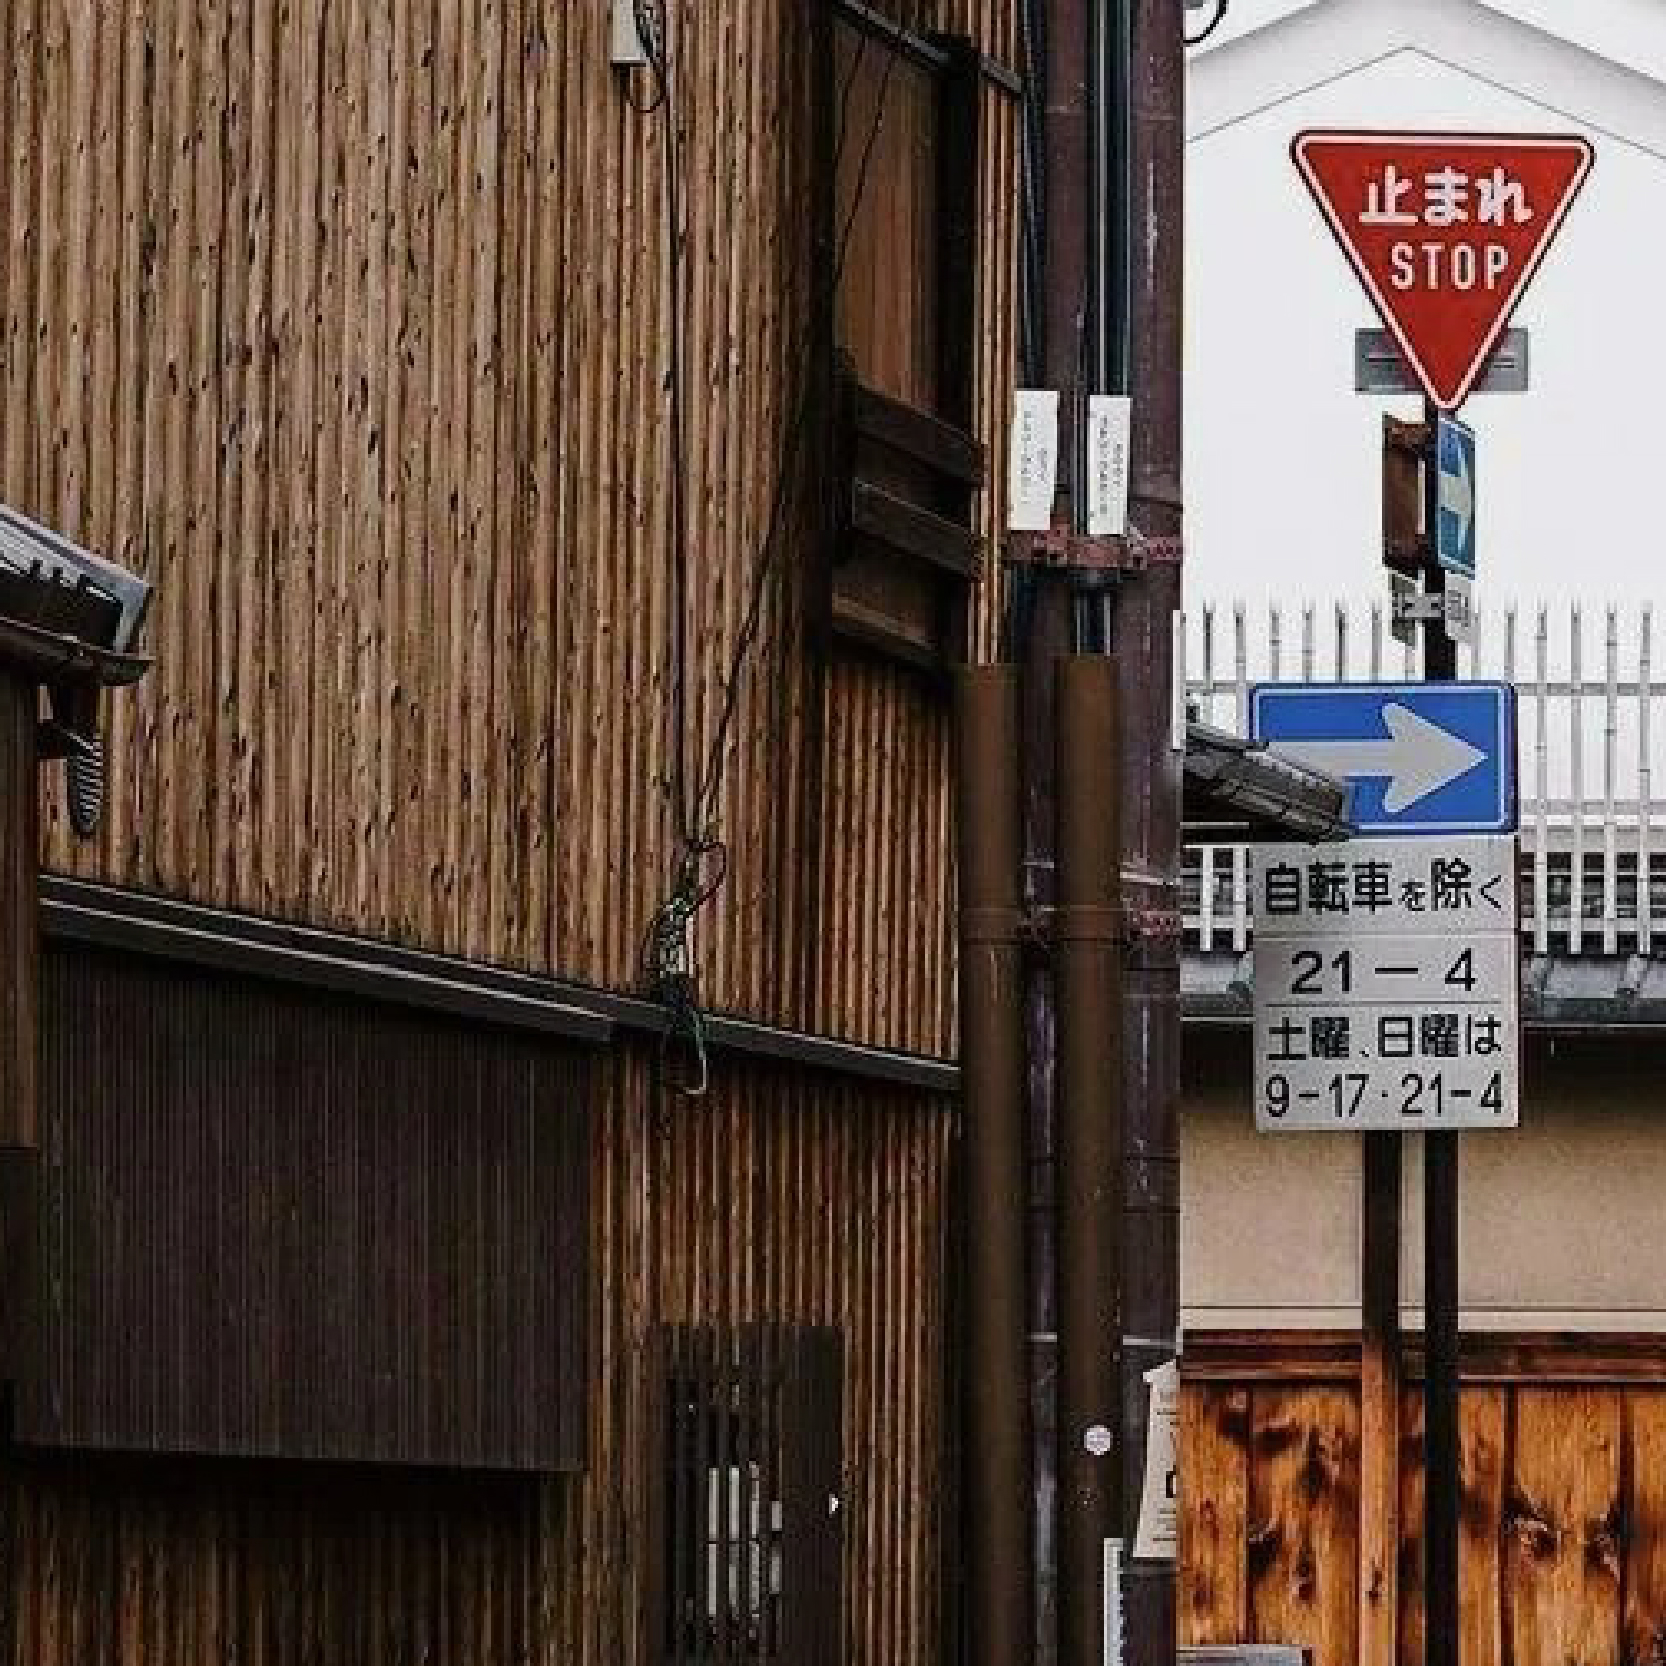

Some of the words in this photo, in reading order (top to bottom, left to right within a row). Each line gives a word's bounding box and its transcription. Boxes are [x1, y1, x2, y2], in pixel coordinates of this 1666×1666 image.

[1358, 164, 1534, 228] 止まれ
[1390, 241, 1510, 291] STOP
[1264, 857, 1504, 914] 自転車を除く
[1267, 1013, 1504, 1062] 土曜、日曜は
